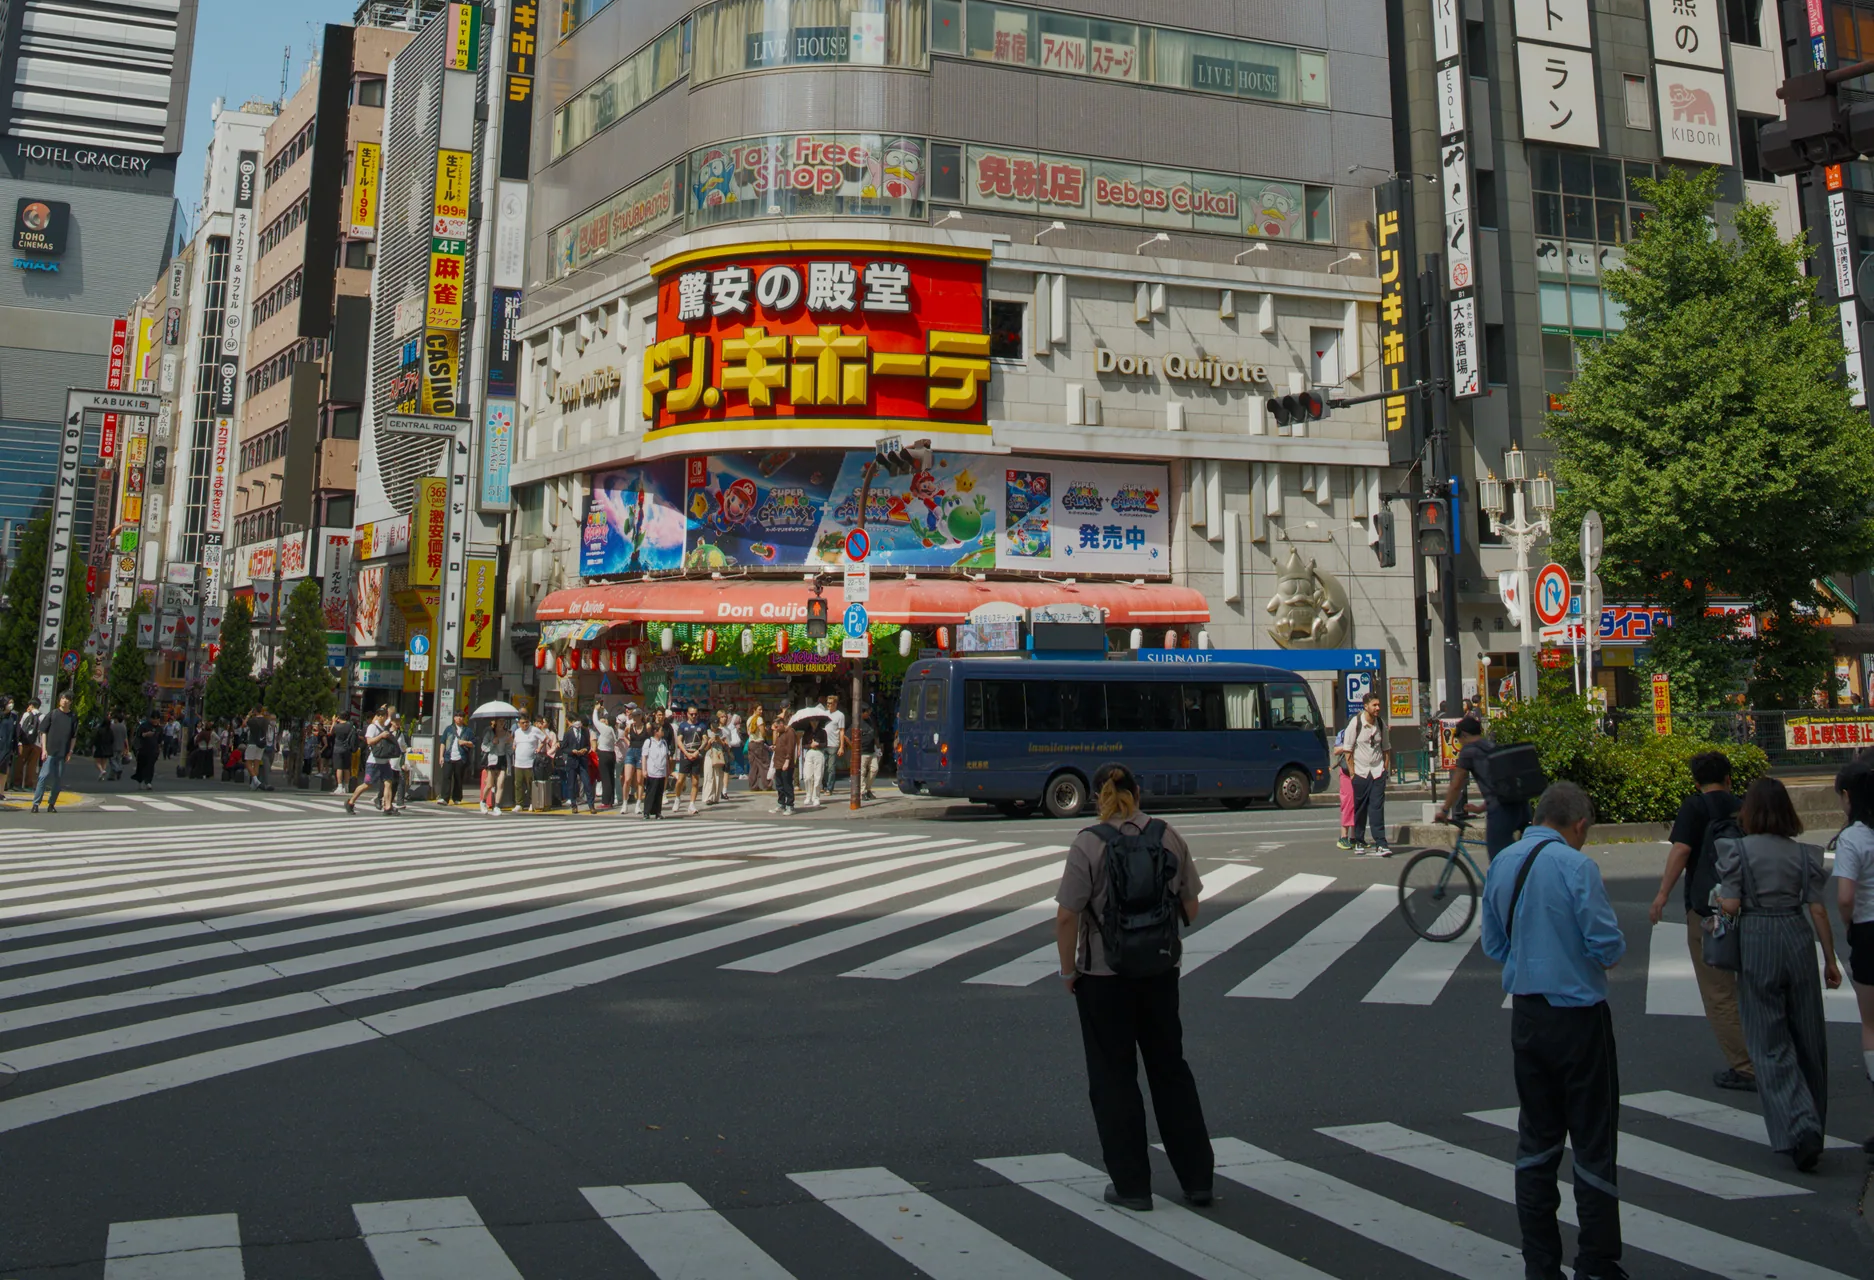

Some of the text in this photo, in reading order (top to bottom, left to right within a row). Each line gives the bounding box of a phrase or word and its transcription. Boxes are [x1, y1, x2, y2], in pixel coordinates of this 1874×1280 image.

[753, 36, 848, 61] LIVE HOUSE
[993, 29, 1027, 65] 新宿
[1043, 38, 1087, 71] アイドル
[1092, 46, 1137, 77] ステージ
[1198, 63, 1278, 94] LIVE HOUSE
[1446, 70, 1455, 132] ESOLA
[1671, 127, 1721, 147] KIBORI
[17, 143, 151, 170] HOTEL GRACERY
[359, 148, 372, 186] 生ビール
[731, 136, 870, 170] Tax Free
[240, 160, 255, 201] Booth
[444, 155, 457, 202] 生ビール
[754, 164, 843, 195] Shop
[978, 155, 1083, 205] 免税店
[437, 204, 466, 216] 199円
[1095, 178, 1237, 217] Bebas Cukai
[1833, 199, 1847, 238] ZEST
[18, 241, 54, 250] CINEMAS
[20, 231, 45, 242] TOHO
[236, 214, 247, 261] ネットカフェ
[438, 240, 459, 253] 4F
[13, 258, 60, 272] IMAX
[172, 269, 182, 297] 東京ビル
[230, 276, 241, 309] カプセル
[433, 258, 460, 305] 麻雀
[678, 262, 911, 320] 驚安の殿堂
[429, 308, 452, 316] スリー
[1453, 304, 1469, 374] 大衆酒場
[426, 334, 455, 414] CASINO
[1095, 346, 1268, 388] Don Quijote
[221, 363, 236, 405] Booth
[558, 366, 622, 405] Don Quijote
[389, 420, 457, 432] CENTRAL ROAD
[211, 427, 228, 529] カラオケ まねきねこ
[430, 487, 447, 497] 365
[765, 496, 809, 507] MARIO
[771, 488, 804, 497] SUPER
[853, 488, 891, 497] SPER
[1062, 495, 1104, 507] GALAXY
[1144, 490, 1159, 513] 2
[757, 506, 816, 522] GALAXY
[887, 496, 911, 522] 2
[45, 429, 79, 628] GODZILLA ROAD
[208, 534, 220, 543] 2F
[1079, 523, 1145, 551] 発売中
[446, 475, 467, 630] ゴジラロード
[331, 572, 342, 594] 九十九
[475, 565, 487, 607] カラオケ
[167, 597, 190, 605] DAN
[568, 600, 605, 616] Don Quijote
[717, 602, 808, 620] Don Quijo
[849, 612, 857, 632] P
[1355, 654, 1362, 666] P
[1349, 678, 1361, 700] P
